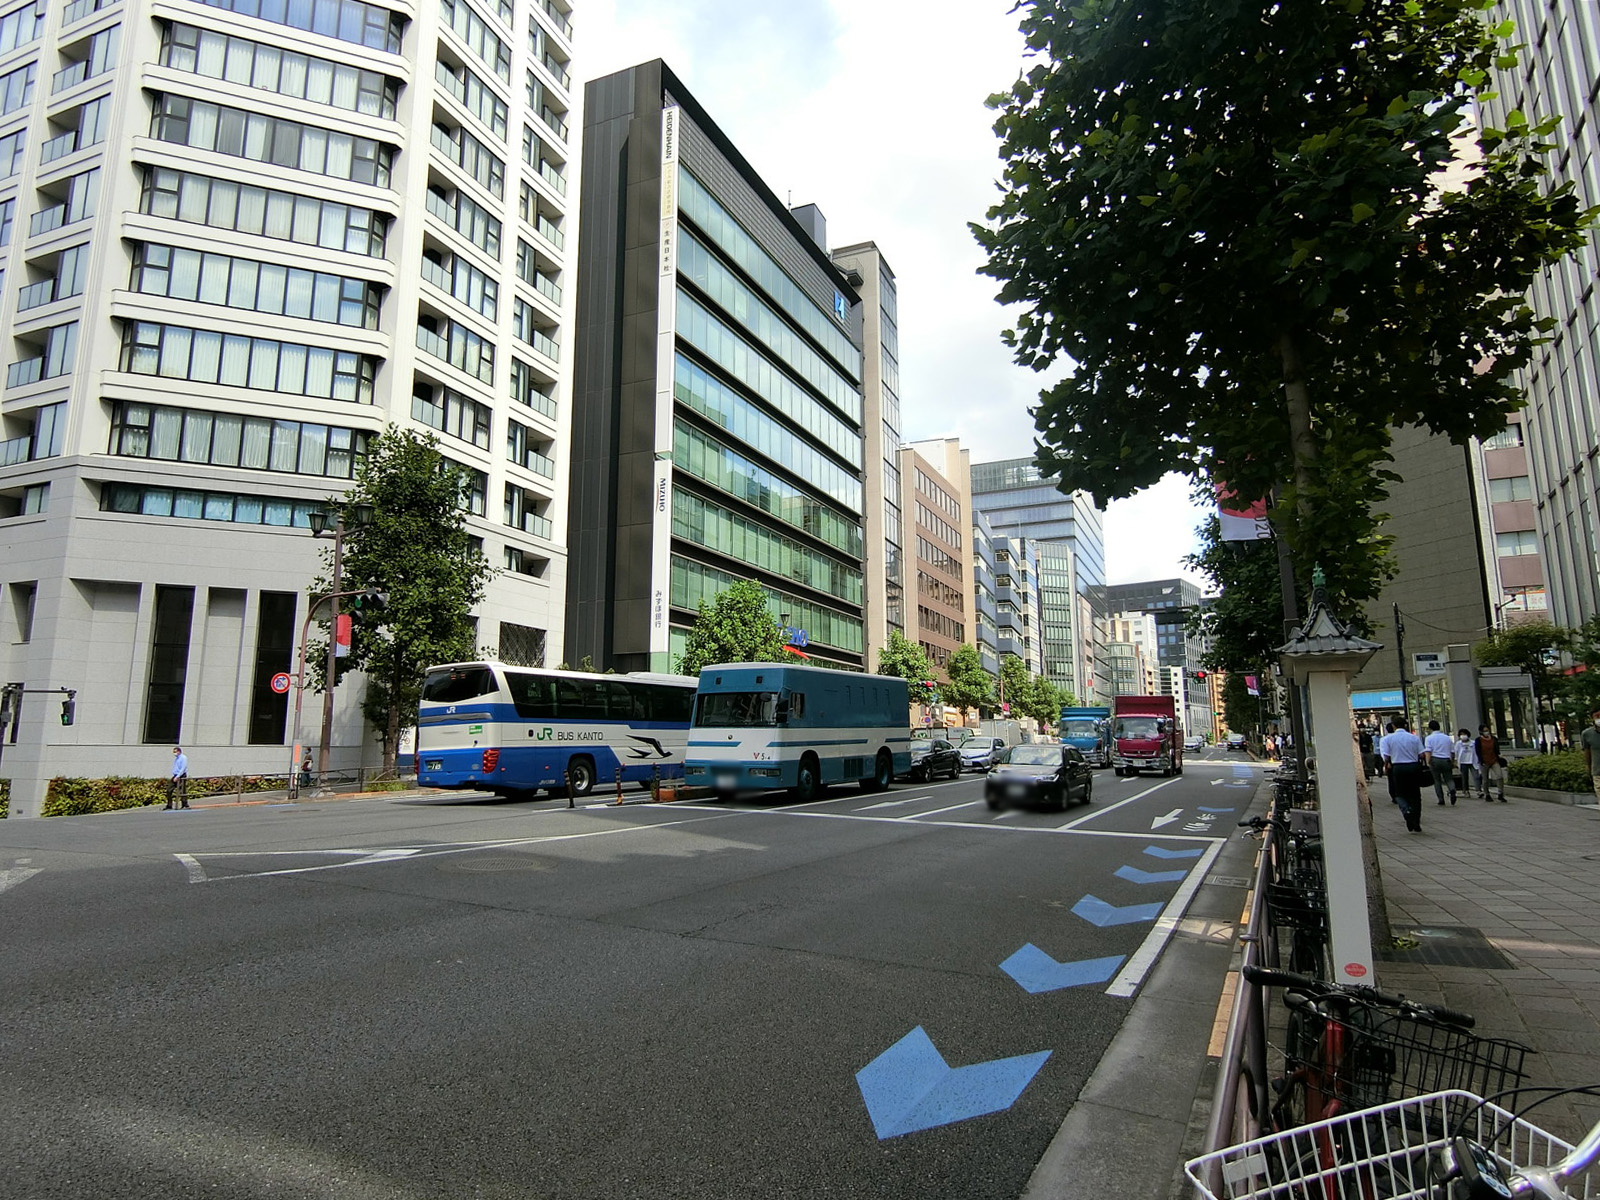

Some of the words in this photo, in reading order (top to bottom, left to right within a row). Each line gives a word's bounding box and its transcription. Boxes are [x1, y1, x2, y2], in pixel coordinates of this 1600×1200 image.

[665, 110, 673, 159] HEIDENHAIN
[654, 590, 662, 629] みずほ銀行
[446, 706, 457, 714] JR
[536, 727, 553, 741] JR
[557, 731, 574, 741] BUS
[577, 731, 604, 741] KANTO
